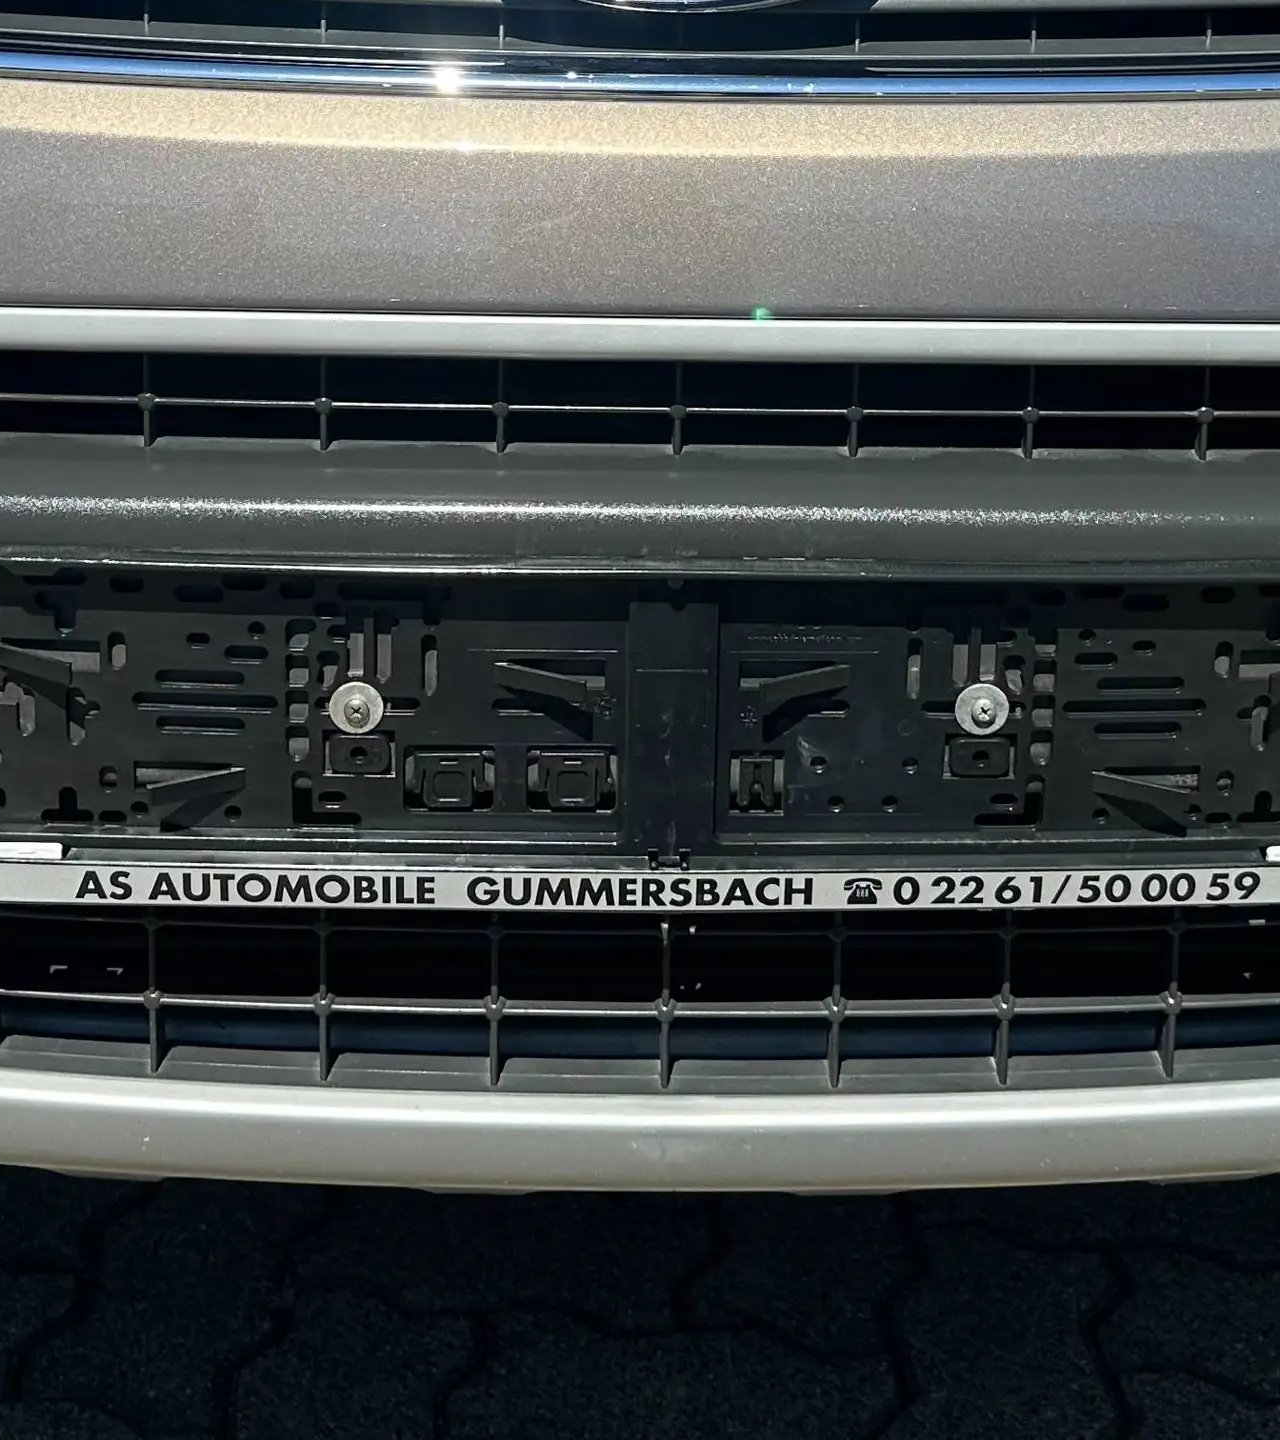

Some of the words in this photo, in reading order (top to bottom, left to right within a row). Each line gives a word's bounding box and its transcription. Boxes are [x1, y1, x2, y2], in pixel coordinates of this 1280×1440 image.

[75, 870, 133, 901] AS
[148, 872, 436, 905] AUTOMOBILE
[466, 877, 813, 906] GUMMERSBACH
[893, 876, 921, 906] 0
